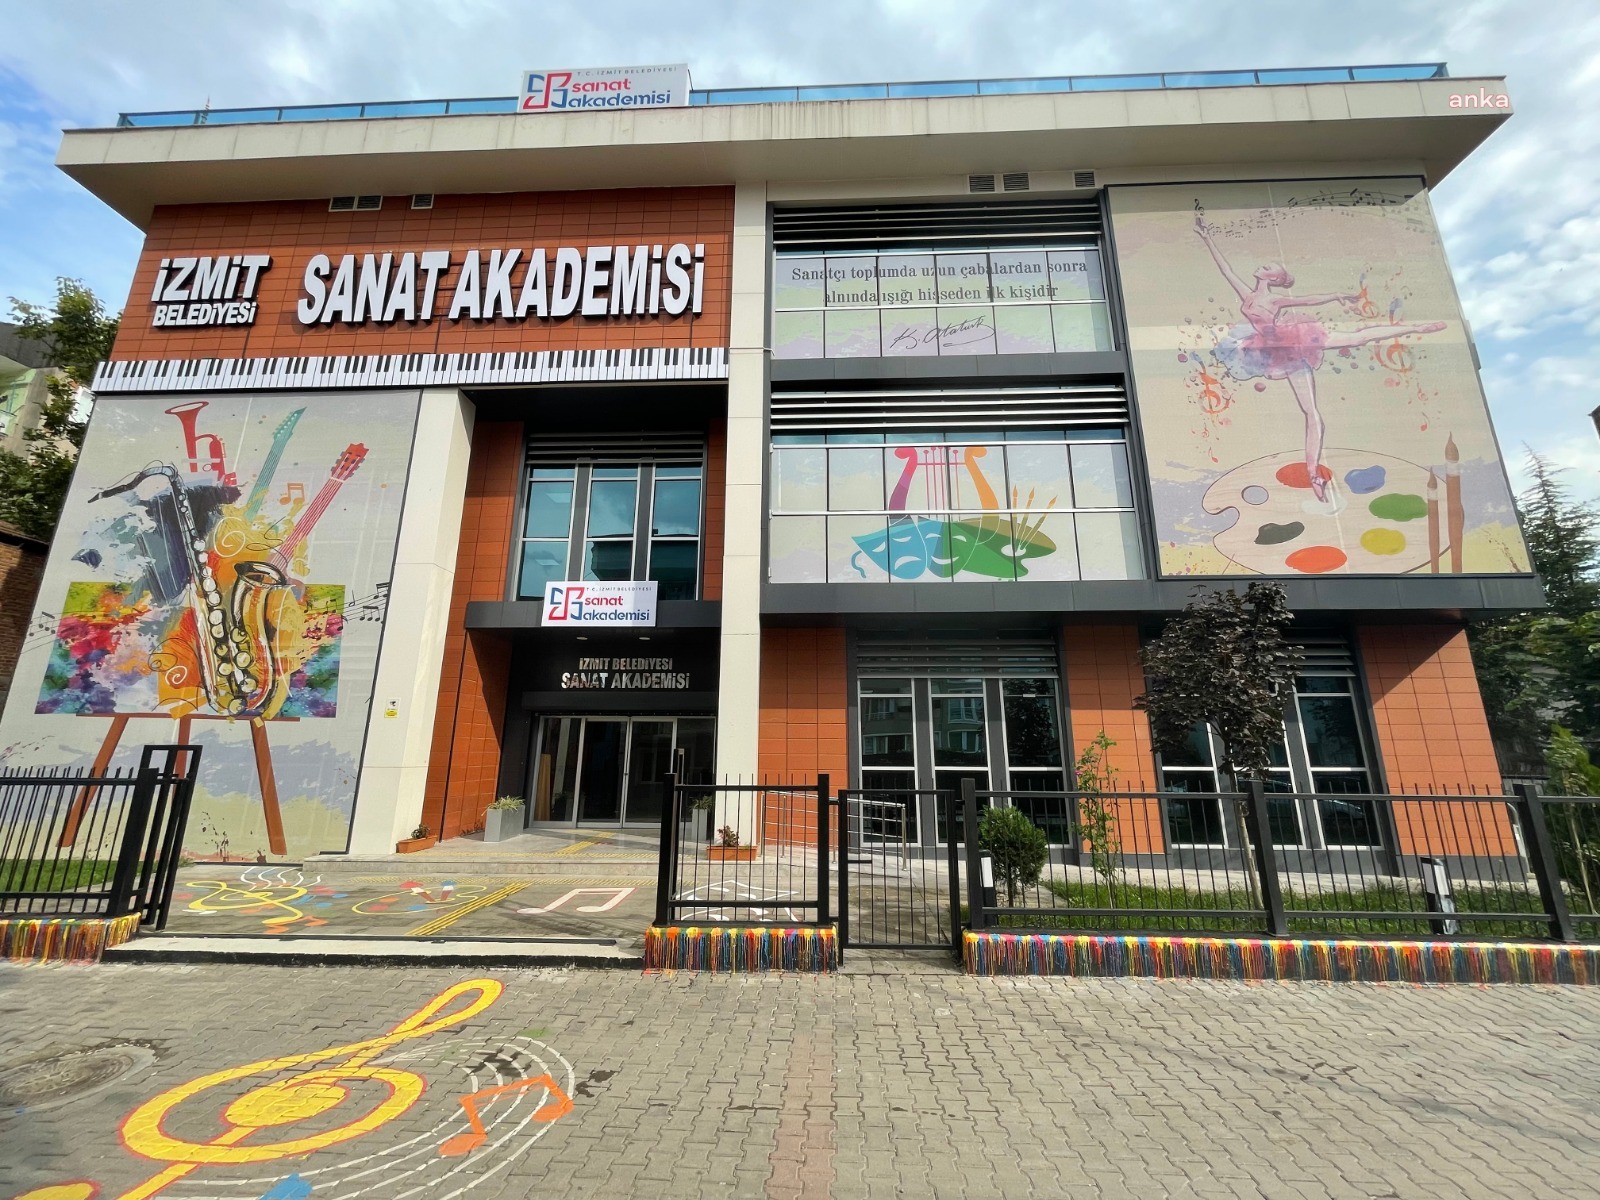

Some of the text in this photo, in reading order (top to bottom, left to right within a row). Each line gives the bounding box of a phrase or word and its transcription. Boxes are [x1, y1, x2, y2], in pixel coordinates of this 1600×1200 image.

[625, 66, 677, 75] BELEDİYESİ
[572, 78, 631, 92] sanat
[568, 90, 671, 108] akademisi
[151, 254, 271, 302] İZMİT
[792, 267, 846, 282] Sanatçı
[851, 265, 917, 282] toplumda
[960, 261, 1042, 279] çabalardan
[1048, 261, 1088, 273] sonra
[297, 243, 705, 325] SANAT AKADEMİSİ
[882, 288, 914, 304] ışığı
[918, 286, 981, 301] hisseden
[1010, 284, 1059, 301] kişidir
[152, 301, 257, 327] BELEDİYESİ
[584, 596, 624, 606] sanat
[583, 609, 650, 621] akademisi
[612, 657, 672, 670] BELEDİYESİ
[561, 672, 690, 689] SANAT AKADEMİSİ
